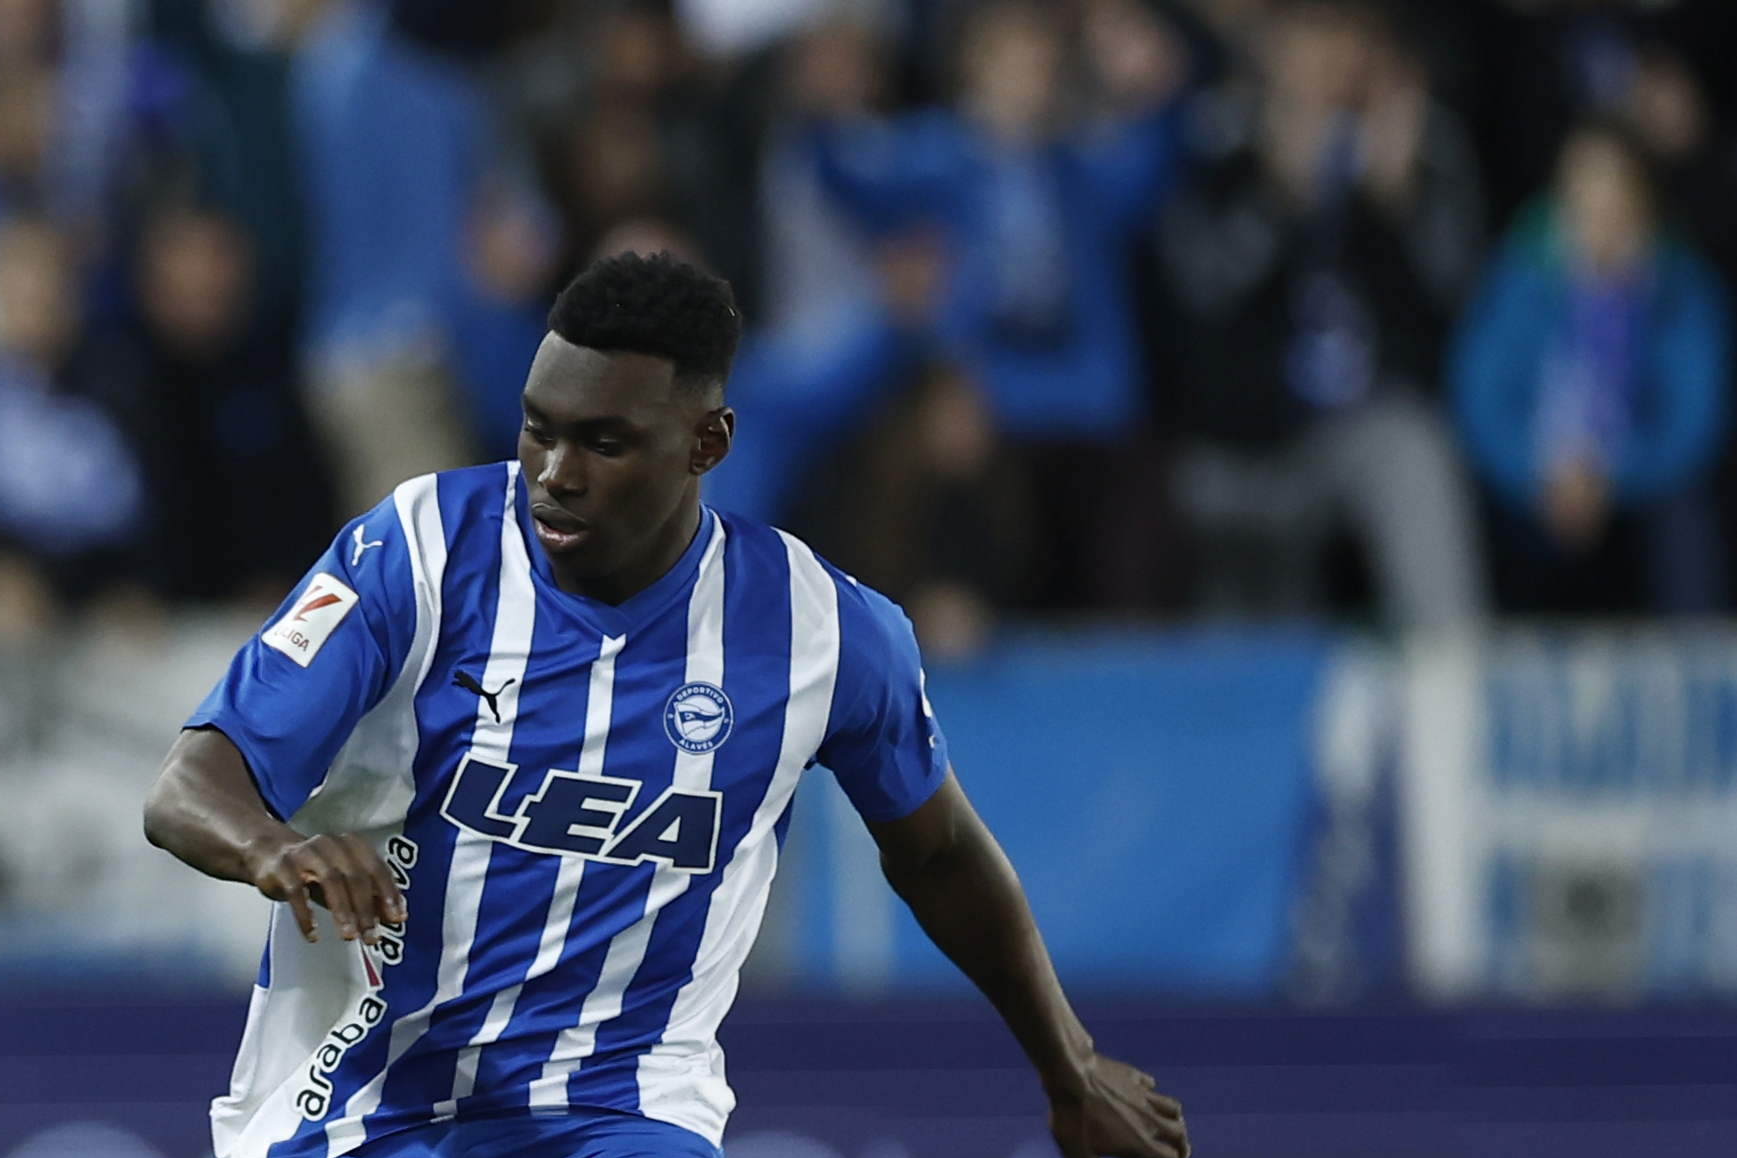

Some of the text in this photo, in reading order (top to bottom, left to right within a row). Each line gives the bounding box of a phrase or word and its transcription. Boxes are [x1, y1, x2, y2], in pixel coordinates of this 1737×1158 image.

[676, 686, 724, 704] DEPORTIVO
[440, 752, 723, 874] LEA
[296, 997, 384, 1118] araba
